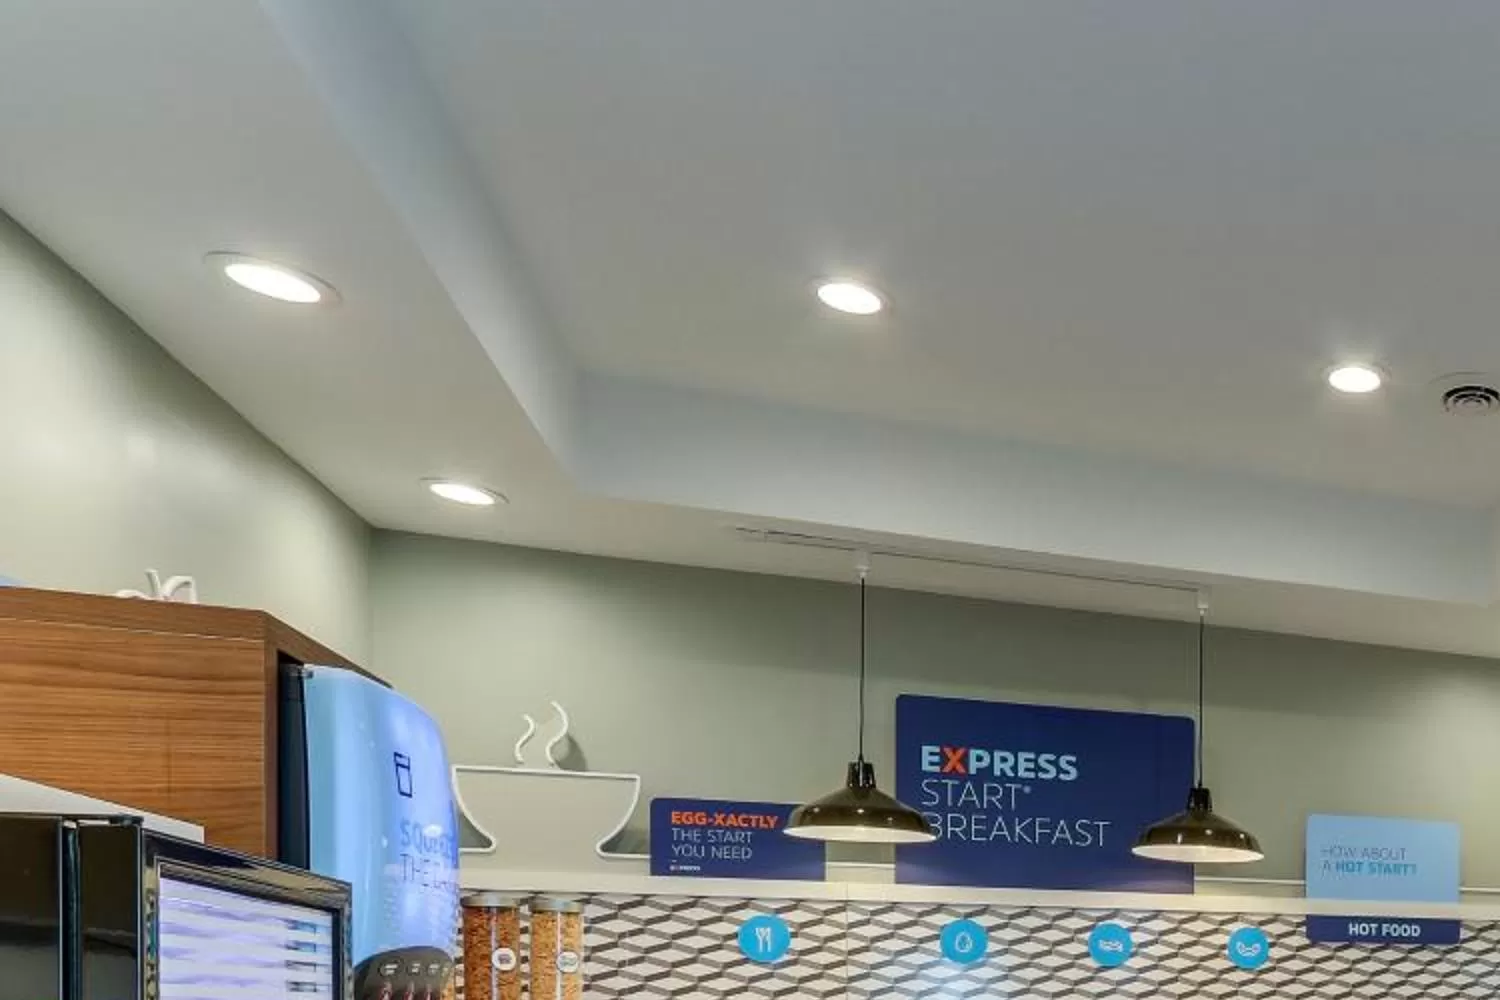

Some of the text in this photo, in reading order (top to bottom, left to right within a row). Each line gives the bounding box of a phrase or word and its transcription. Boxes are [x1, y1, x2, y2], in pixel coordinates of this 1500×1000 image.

[921, 745, 1078, 780] EXPRESS
[671, 811, 778, 829] EGG-XACTLY
[672, 828, 752, 843] THE START
[672, 843, 752, 860] YOU NEED
[1321, 845, 1407, 861] HOW ABOUT
[1336, 861, 1364, 873] HOT
[1348, 923, 1421, 937] HOT FOOD
